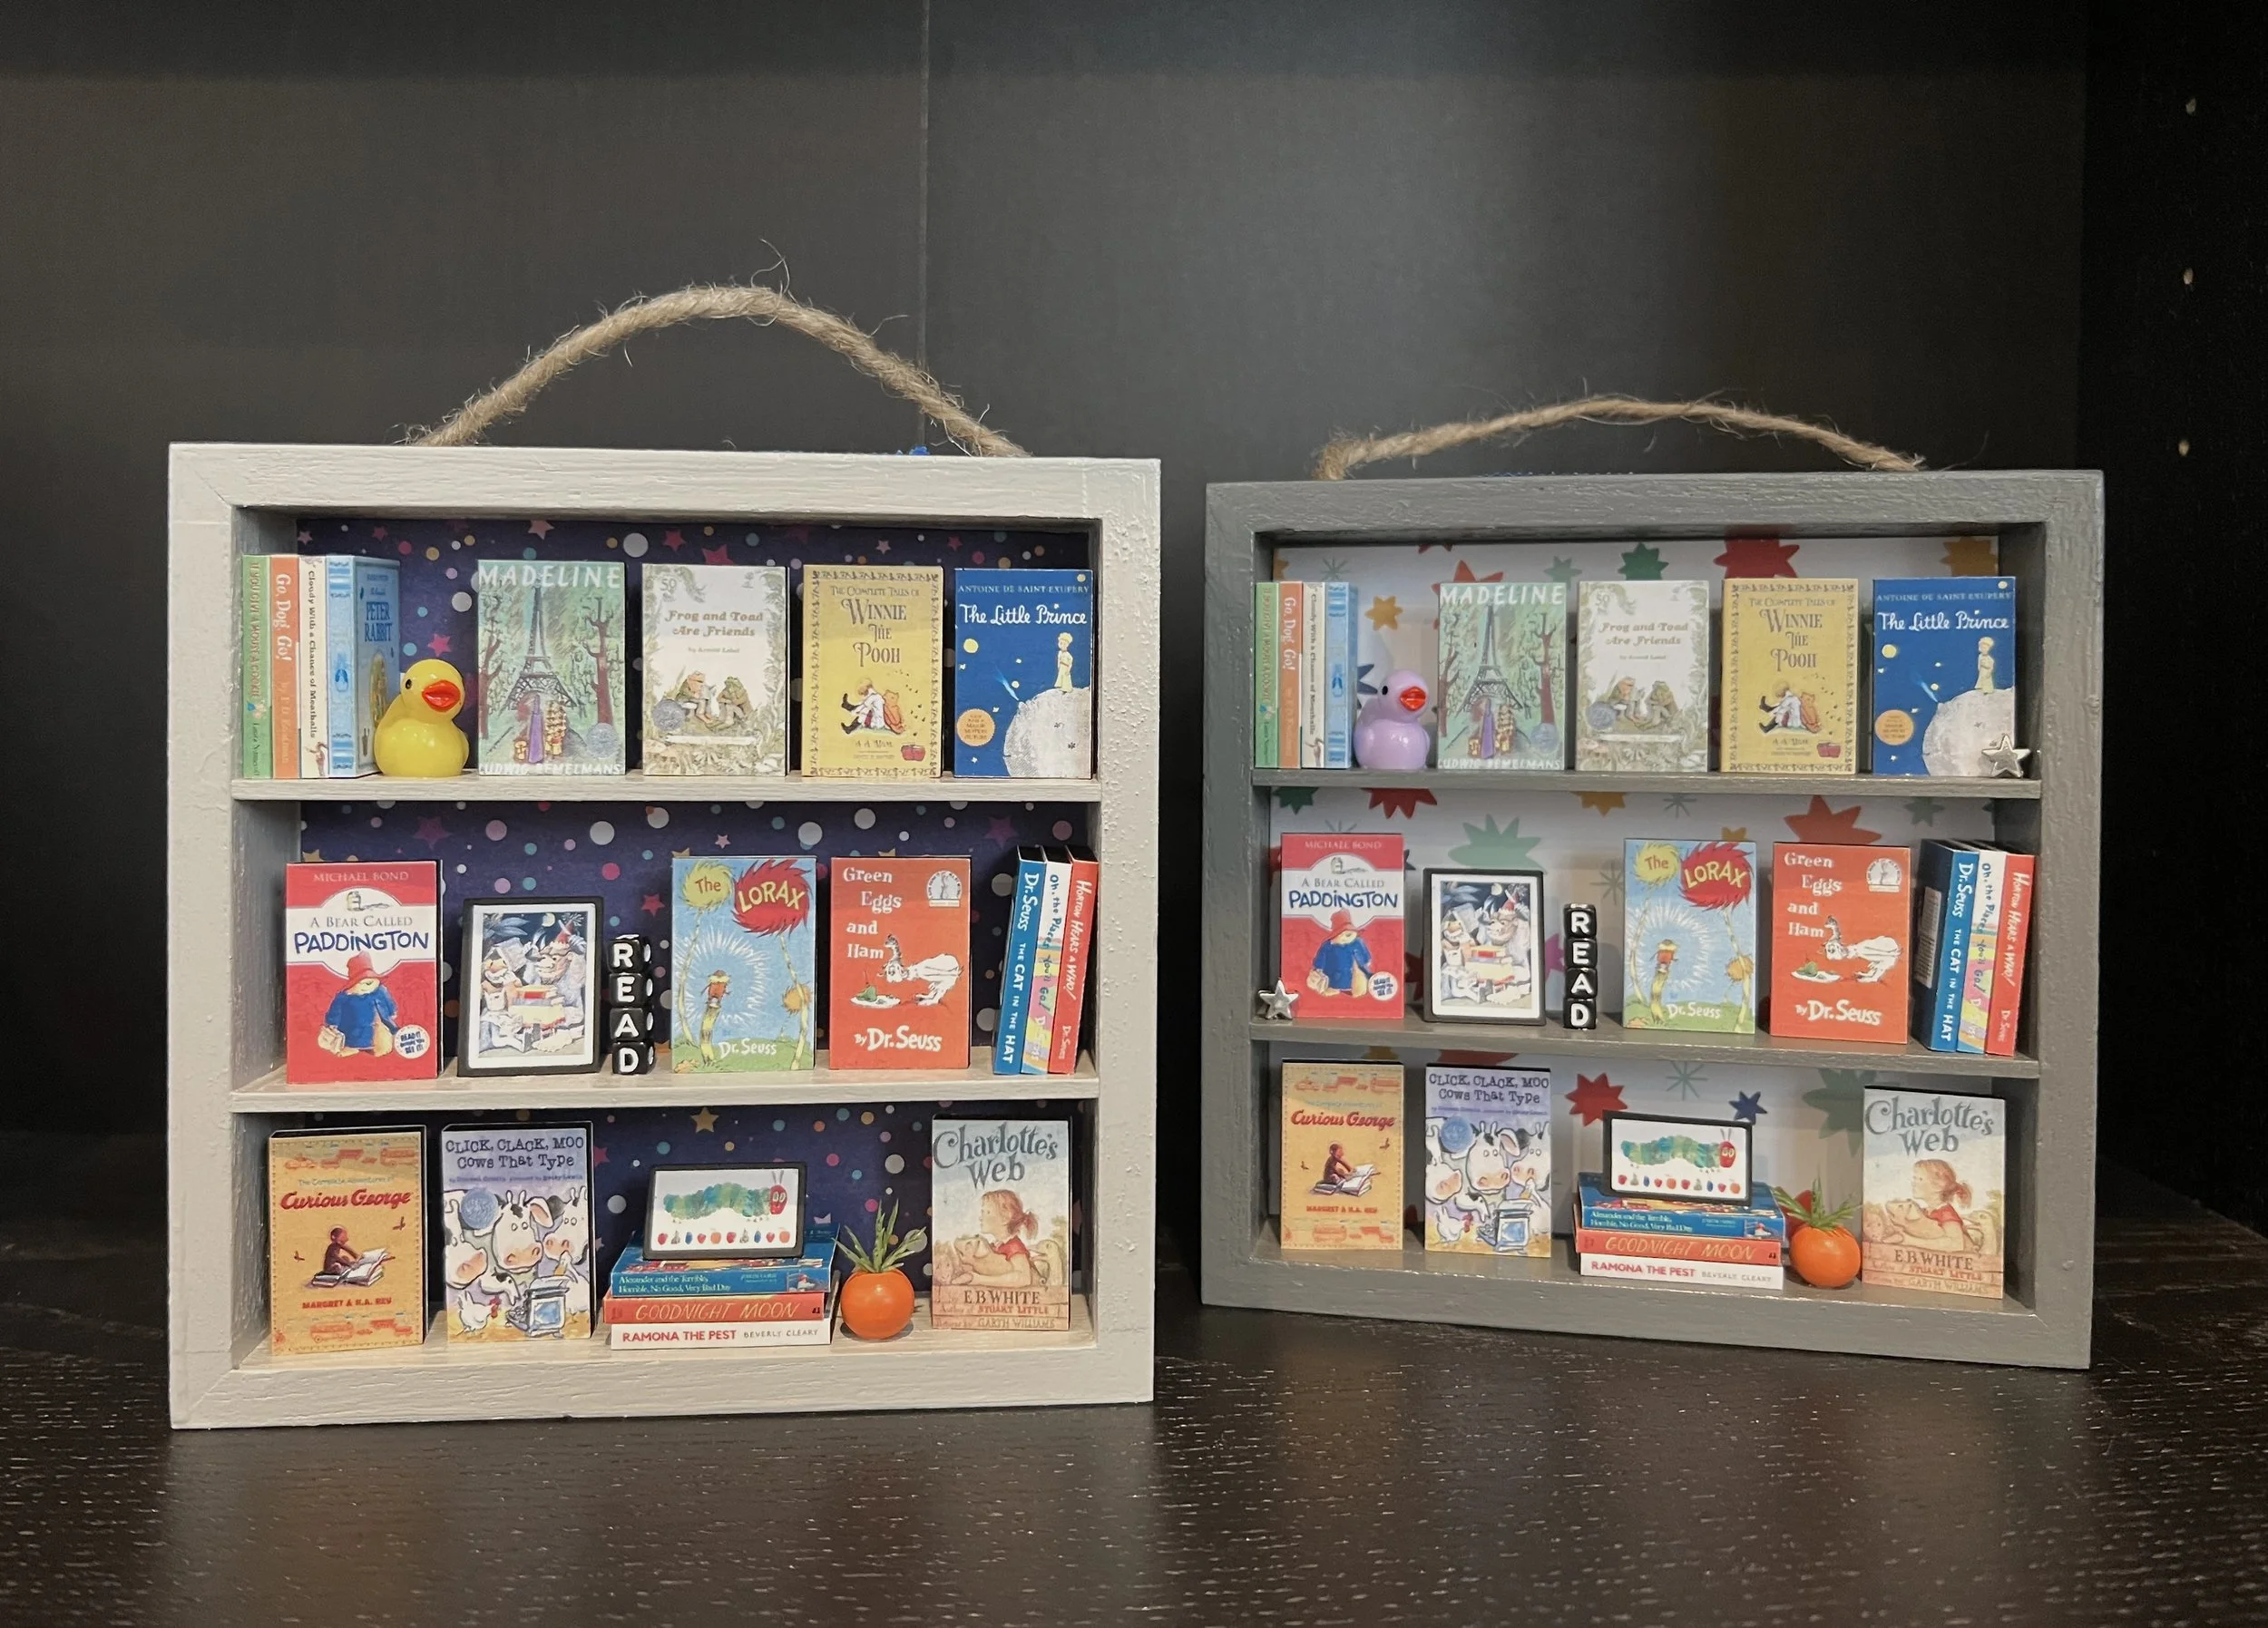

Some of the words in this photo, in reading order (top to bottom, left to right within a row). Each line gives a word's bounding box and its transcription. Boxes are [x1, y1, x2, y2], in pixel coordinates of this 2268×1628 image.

[276, 573, 291, 596] Go,
[478, 566, 621, 588] MADELINE
[958, 585, 1000, 593] ANTOINE
[1440, 584, 1564, 605] MADELINE
[1877, 593, 1919, 601] ANTOINE
[366, 601, 391, 620] PETER
[665, 609, 699, 622] Frog
[703, 609, 727, 621] and
[729, 609, 764, 621] Toad
[841, 599, 907, 625] WINNIE
[959, 603, 987, 624] The
[990, 605, 1031, 624] Little
[1034, 602, 1088, 625] Prince
[1877, 611, 1905, 630] The
[1908, 612, 1950, 630] Little
[1954, 609, 2009, 629] Prince
[1600, 622, 1631, 633] Frog
[1633, 622, 1655, 631] and
[1657, 622, 1688, 631] Toad
[1759, 609, 1823, 633] WINNIE
[365, 623, 392, 642] RABBIT
[672, 625, 700, 637] Are
[703, 625, 755, 638] Friends
[276, 635, 292, 660] Go!
[1606, 636, 1630, 646] Are
[1633, 636, 1681, 647] Friends
[853, 642, 900, 667] POOH
[1284, 649, 1296, 670] Go!
[1770, 648, 1817, 671] POOH
[310, 678, 317, 687] of
[1305, 840, 1349, 850] MICHAEL
[1352, 840, 1382, 849] BOND
[1645, 856, 1668, 871] The
[1784, 852, 1833, 868] Green
[313, 872, 367, 882] MICHAEL
[373, 871, 409, 882] BOND
[843, 867, 892, 883] Green
[1684, 861, 1747, 888] LORAX
[1959, 863, 1974, 882] Dr.
[695, 876, 721, 894] The
[1024, 872, 1040, 894] Dr.
[1301, 878, 1310, 888] A
[1314, 878, 1340, 888] BEAR
[1344, 878, 1384, 889] CALLED
[1802, 874, 1843, 896] Eggs
[738, 881, 806, 912] LORAX
[861, 891, 902, 913] Eggs
[1074, 880, 1092, 918] HORTON
[1951, 883, 1973, 918] Seuss
[1985, 885, 1993, 901] the
[1017, 895, 1039, 931] Seuss
[1787, 902, 1818, 915] and
[310, 917, 320, 928] A
[327, 916, 357, 928] BEAR
[363, 915, 413, 927] CALLED
[846, 920, 878, 935] and
[1788, 921, 1824, 938] Ham
[1070, 920, 1083, 953] HEARS
[1953, 929, 1961, 945] THE
[846, 943, 885, 960] Ham
[1017, 943, 1026, 960] THE
[1950, 948, 1960, 973] CAT
[1012, 963, 1025, 991] CAT
[1570, 911, 1593, 1028] READ
[1062, 964, 1077, 1000] WHO!
[1949, 978, 1957, 989] IN
[612, 942, 640, 1073] READ
[1012, 996, 1020, 1007] IN
[1667, 1004, 1686, 1018] Dr.
[1687, 1002, 1721, 1019] Seuss
[1946, 993, 1955, 1009] THE
[1009, 1012, 1018, 1029] THE
[1795, 1003, 1807, 1016] By
[1807, 999, 1833, 1021] Dr.
[1836, 999, 1882, 1026] Seuss
[1941, 1014, 1953, 1041] HAT
[718, 1041, 739, 1058] Dr.
[741, 1038, 777, 1056] Seuss
[854, 1034, 866, 1046] By
[866, 1027, 894, 1052] Dr.
[895, 1025, 943, 1052] Seuss
[1002, 1035, 1016, 1064] HAT
[1429, 1073, 1471, 1087] CLICK,
[1473, 1075, 1518, 1088] CLACK,
[1521, 1076, 1549, 1088] MOO
[1474, 1089, 1504, 1103] That
[1508, 1091, 1540, 1106] Type
[1291, 1109, 1344, 1127] Curious
[1346, 1111, 1394, 1129] George
[1865, 1096, 1994, 1136] Charlotte's
[445, 1138, 494, 1153] CLICK,
[497, 1137, 548, 1153] CLACK,
[552, 1136, 584, 1149] MOO
[933, 1122, 1058, 1168] Charlotte's
[1899, 1126, 1959, 1156] Web
[457, 1155, 494, 1169] Cows
[499, 1155, 533, 1168] That
[539, 1154, 574, 1170] Type
[965, 1154, 1025, 1189] Web
[279, 1191, 348, 1210] Curious
[351, 1188, 411, 1210] George
[1605, 1236, 1698, 1256] GOODNIGHT
[1702, 1243, 1758, 1261] MOON
[1591, 1262, 1643, 1273] RAMONA
[1647, 1264, 1667, 1275] THE
[1669, 1267, 1696, 1277] PEST
[1921, 1252, 1973, 1270] WHITE
[686, 1283, 699, 1292] Very
[718, 1282, 731, 1292] Day
[989, 1290, 1041, 1305] WHITE
[635, 1302, 738, 1321] GOODNIGHT
[741, 1302, 800, 1319] MOON
[622, 1331, 679, 1342] RAMONA
[683, 1331, 706, 1340] THE
[709, 1330, 737, 1340] PEST
[743, 1331, 781, 1339] BEVERLY
[786, 1329, 818, 1337] CLEARY
